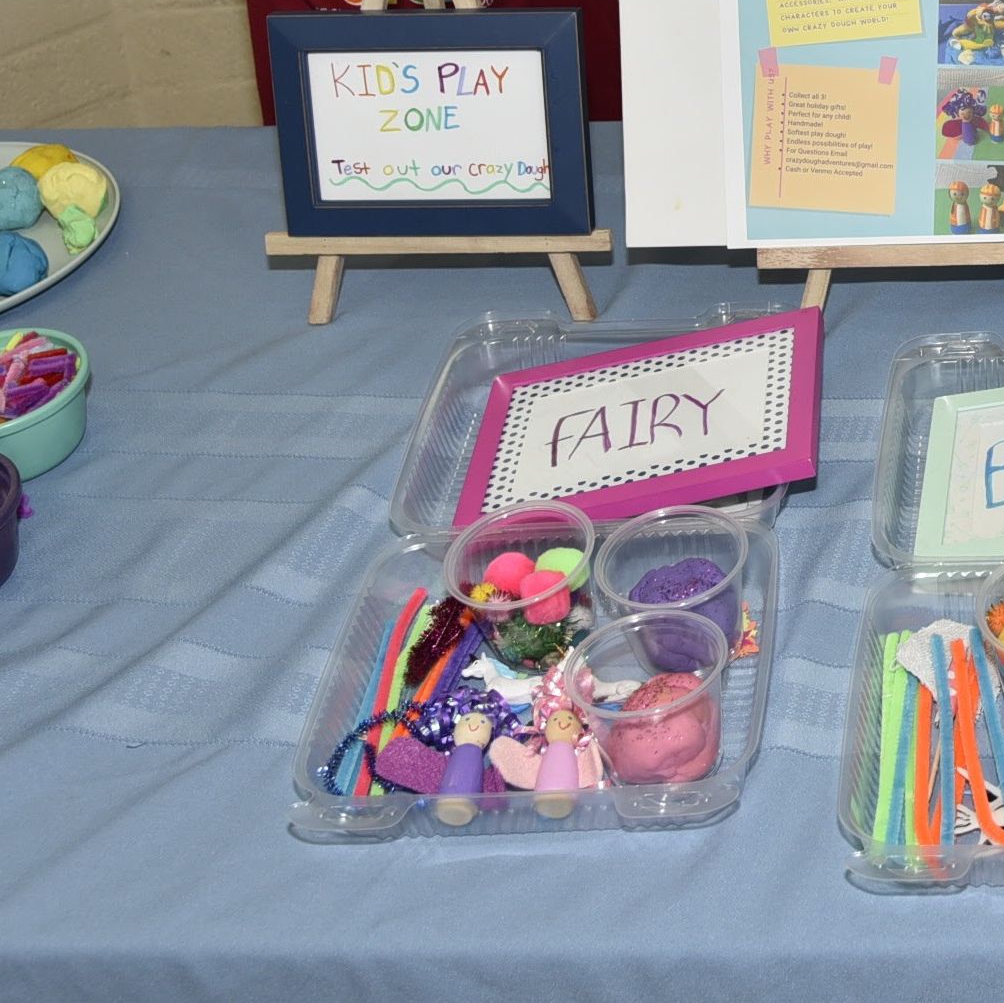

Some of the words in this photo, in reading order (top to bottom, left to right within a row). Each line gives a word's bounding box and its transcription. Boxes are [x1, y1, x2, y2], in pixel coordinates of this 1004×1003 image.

[781, 10, 828, 21] CHARACTERS
[846, 6, 873, 14] CREATE
[782, 26, 799, 34] OWN
[803, 23, 827, 31] CRAZY
[831, 20, 856, 28] DOUGH
[331, 62, 419, 97] KID'S
[438, 62, 509, 96] PLAY
[807, 102, 829, 111] holiday
[380, 106, 459, 132] ZONE
[788, 120, 823, 128] Handmade!
[764, 116, 773, 140] PLAY
[332, 159, 370, 175] Test
[383, 160, 420, 176] out
[431, 165, 462, 176] our
[786, 157, 893, 169] crazydoughadventures@gmail.com
[834, 169, 863, 177] Accepted
[545, 388, 726, 467] FAIRY
